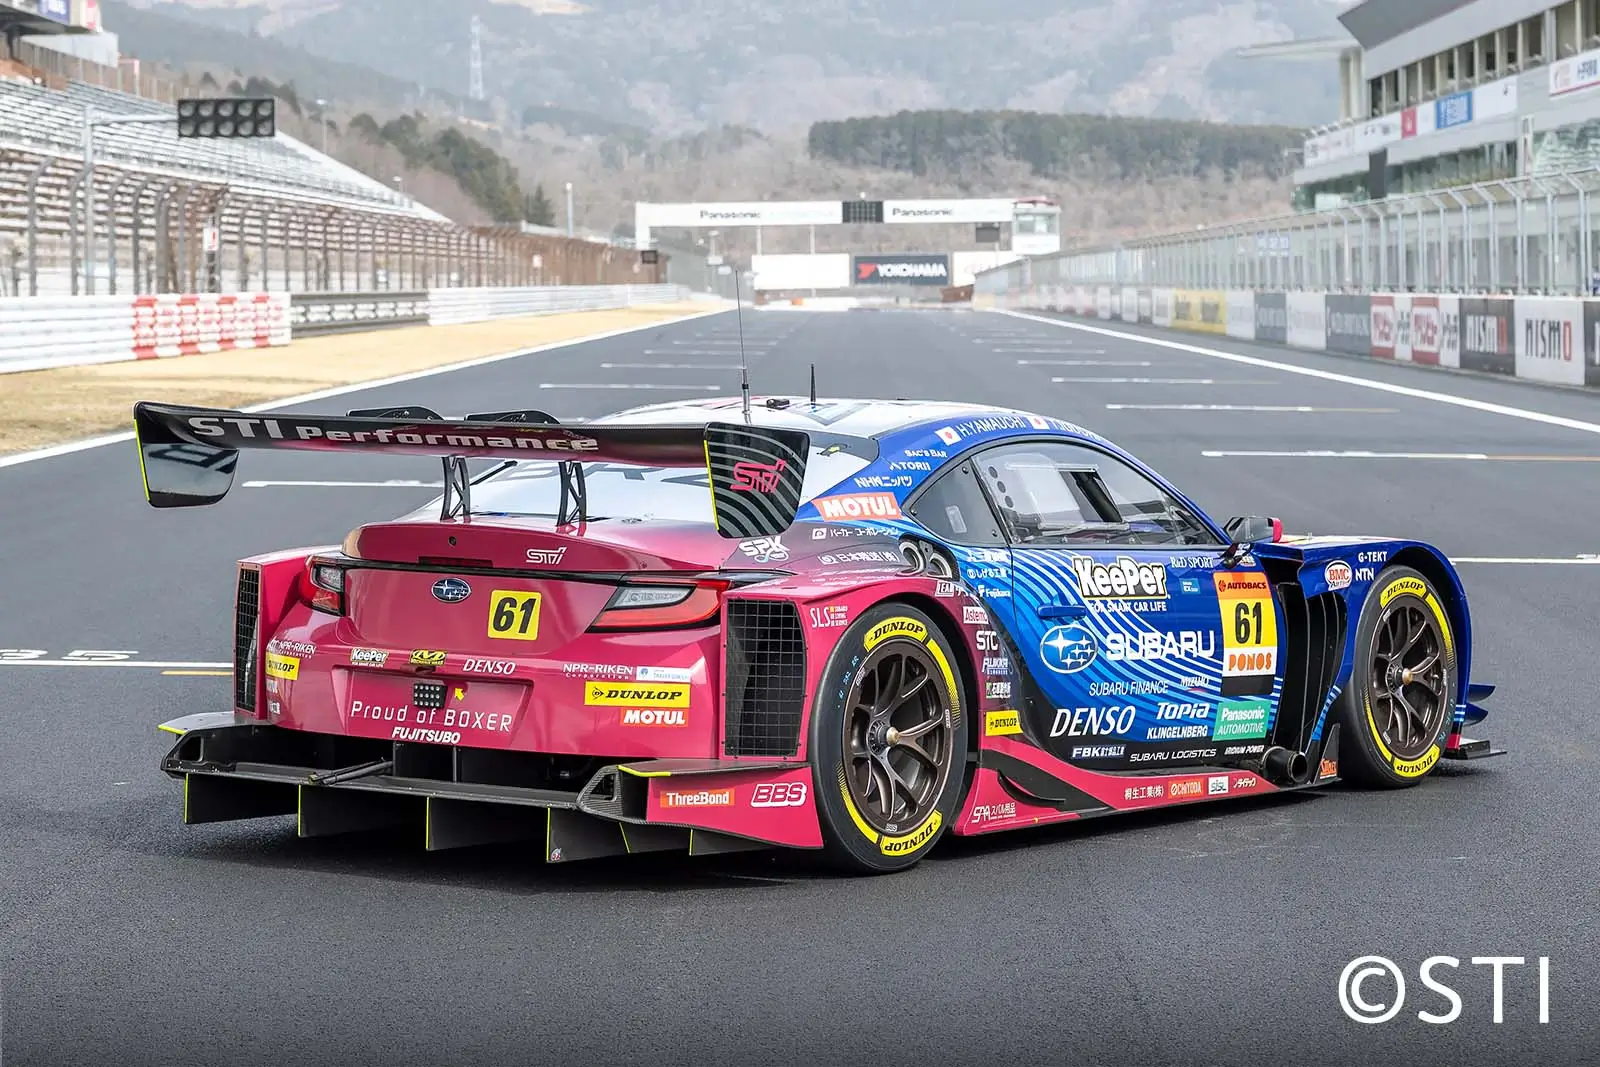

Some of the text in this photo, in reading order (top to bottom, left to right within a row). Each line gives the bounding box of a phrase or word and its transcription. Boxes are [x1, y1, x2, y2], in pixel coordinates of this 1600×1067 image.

[700, 209, 761, 219] Panasonic
[892, 207, 953, 217] Panasonic
[877, 263, 946, 278] YOKOHAMA
[187, 417, 600, 450] STI Performance
[956, 415, 1026, 436] H.YAMAUCHI
[823, 495, 897, 519] MOTUL
[739, 534, 790, 556] SPK
[526, 547, 567, 564] STI
[1188, 557, 1214, 568] SPORT
[1074, 557, 1166, 597] KeePer
[1329, 569, 1349, 580] BMC
[1355, 568, 1375, 581] NTN
[1227, 581, 1266, 590] AUTOBACS
[1387, 582, 1424, 598] DUNLOP
[1134, 602, 1149, 611] CAR
[1150, 601, 1167, 611] LIFE
[493, 597, 537, 635] 61
[810, 606, 831, 628] SLS
[1235, 601, 1262, 645] 61
[873, 621, 924, 638] DUNLOP
[976, 631, 999, 650] STC
[1106, 630, 1214, 661] SUBARU
[351, 648, 387, 662] KeePer
[1229, 654, 1272, 671] PONOS
[463, 658, 516, 675] DENSO
[563, 664, 633, 675] NPR-RIKEN
[606, 689, 683, 700] DUNLOP
[1089, 680, 1169, 696] SUBARU FINANCE
[351, 701, 513, 732] Proud of BOXER
[624, 710, 686, 724] MOTUL
[1221, 705, 1265, 721] Panasonic
[995, 718, 1018, 727] DUNLOP
[1050, 706, 1136, 737] DENSO
[1217, 722, 1264, 735] AUTOMOTIVE
[392, 727, 461, 744] FUJITSUBO
[1147, 725, 1208, 739] KLINGELNBERG
[1130, 749, 1217, 762] SUBARU LOGISTICS
[1397, 755, 1434, 773] DUNLOP
[666, 791, 729, 806] ThreeBond
[751, 782, 807, 807] BBS
[884, 823, 935, 852] DUNLOP
